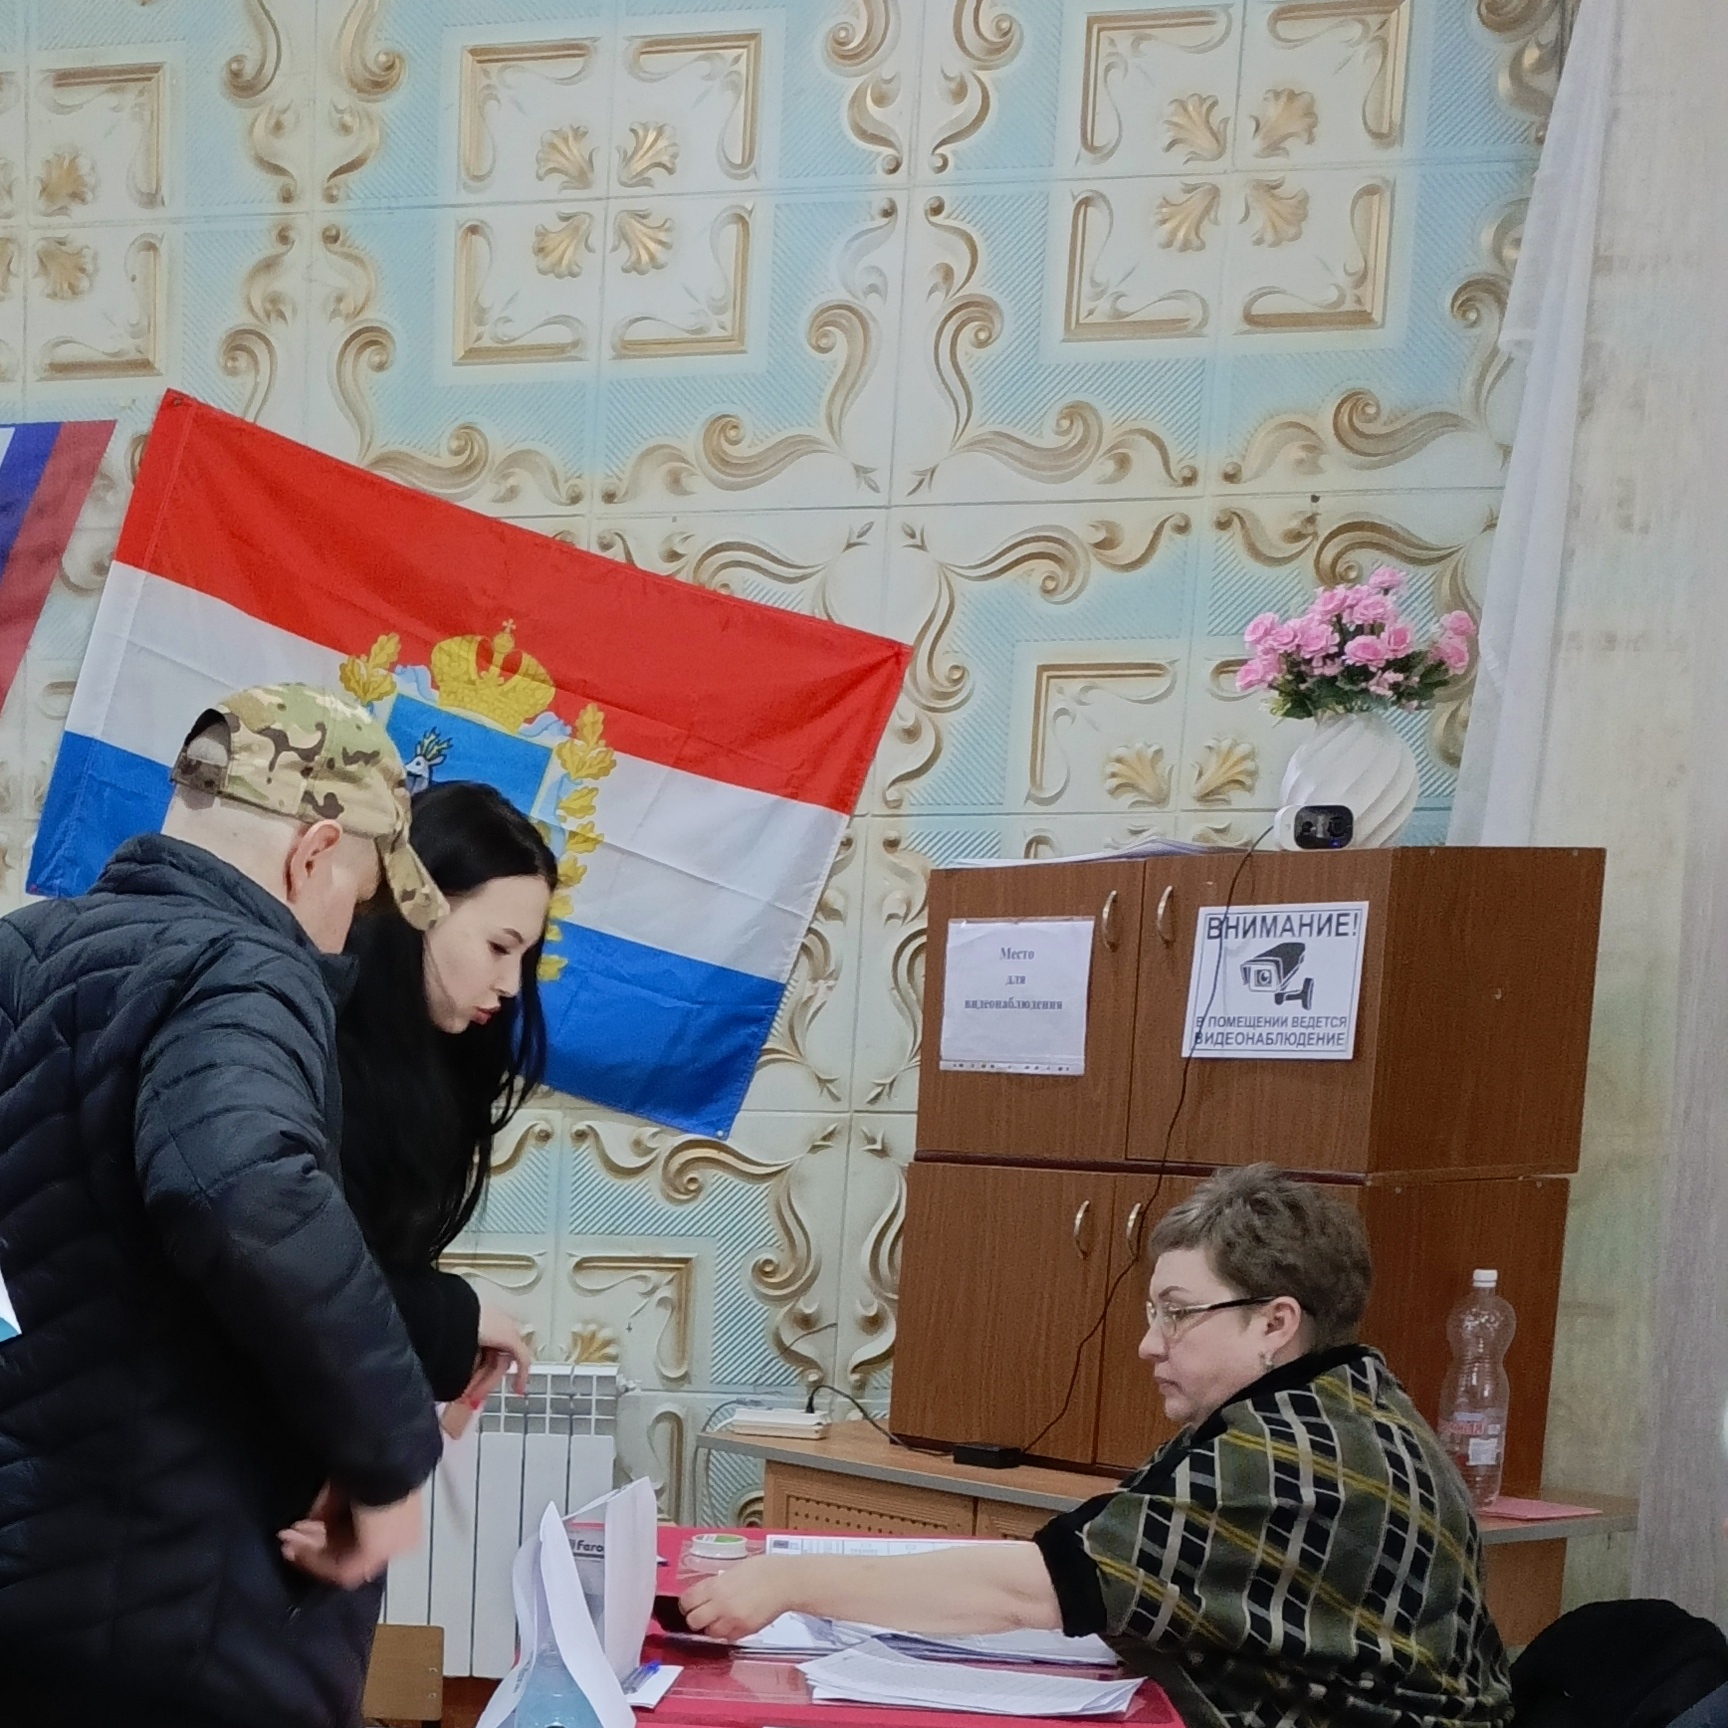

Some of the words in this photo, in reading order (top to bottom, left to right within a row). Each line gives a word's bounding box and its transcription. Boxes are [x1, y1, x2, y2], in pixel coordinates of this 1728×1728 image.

[1206, 912, 1359, 940] ВНИМАНИЕ!
[999, 947, 1035, 960] Место
[1005, 975, 1026, 986] для
[964, 996, 1063, 1010] видеонаблюдения
[1208, 1016, 1289, 1028] ПОМЕЩЕНИИ
[1291, 1016, 1347, 1029] ВЕДЕТСЯ
[1195, 1032, 1346, 1048] ВИДЕОНАБЛЮДЕНИЕ
